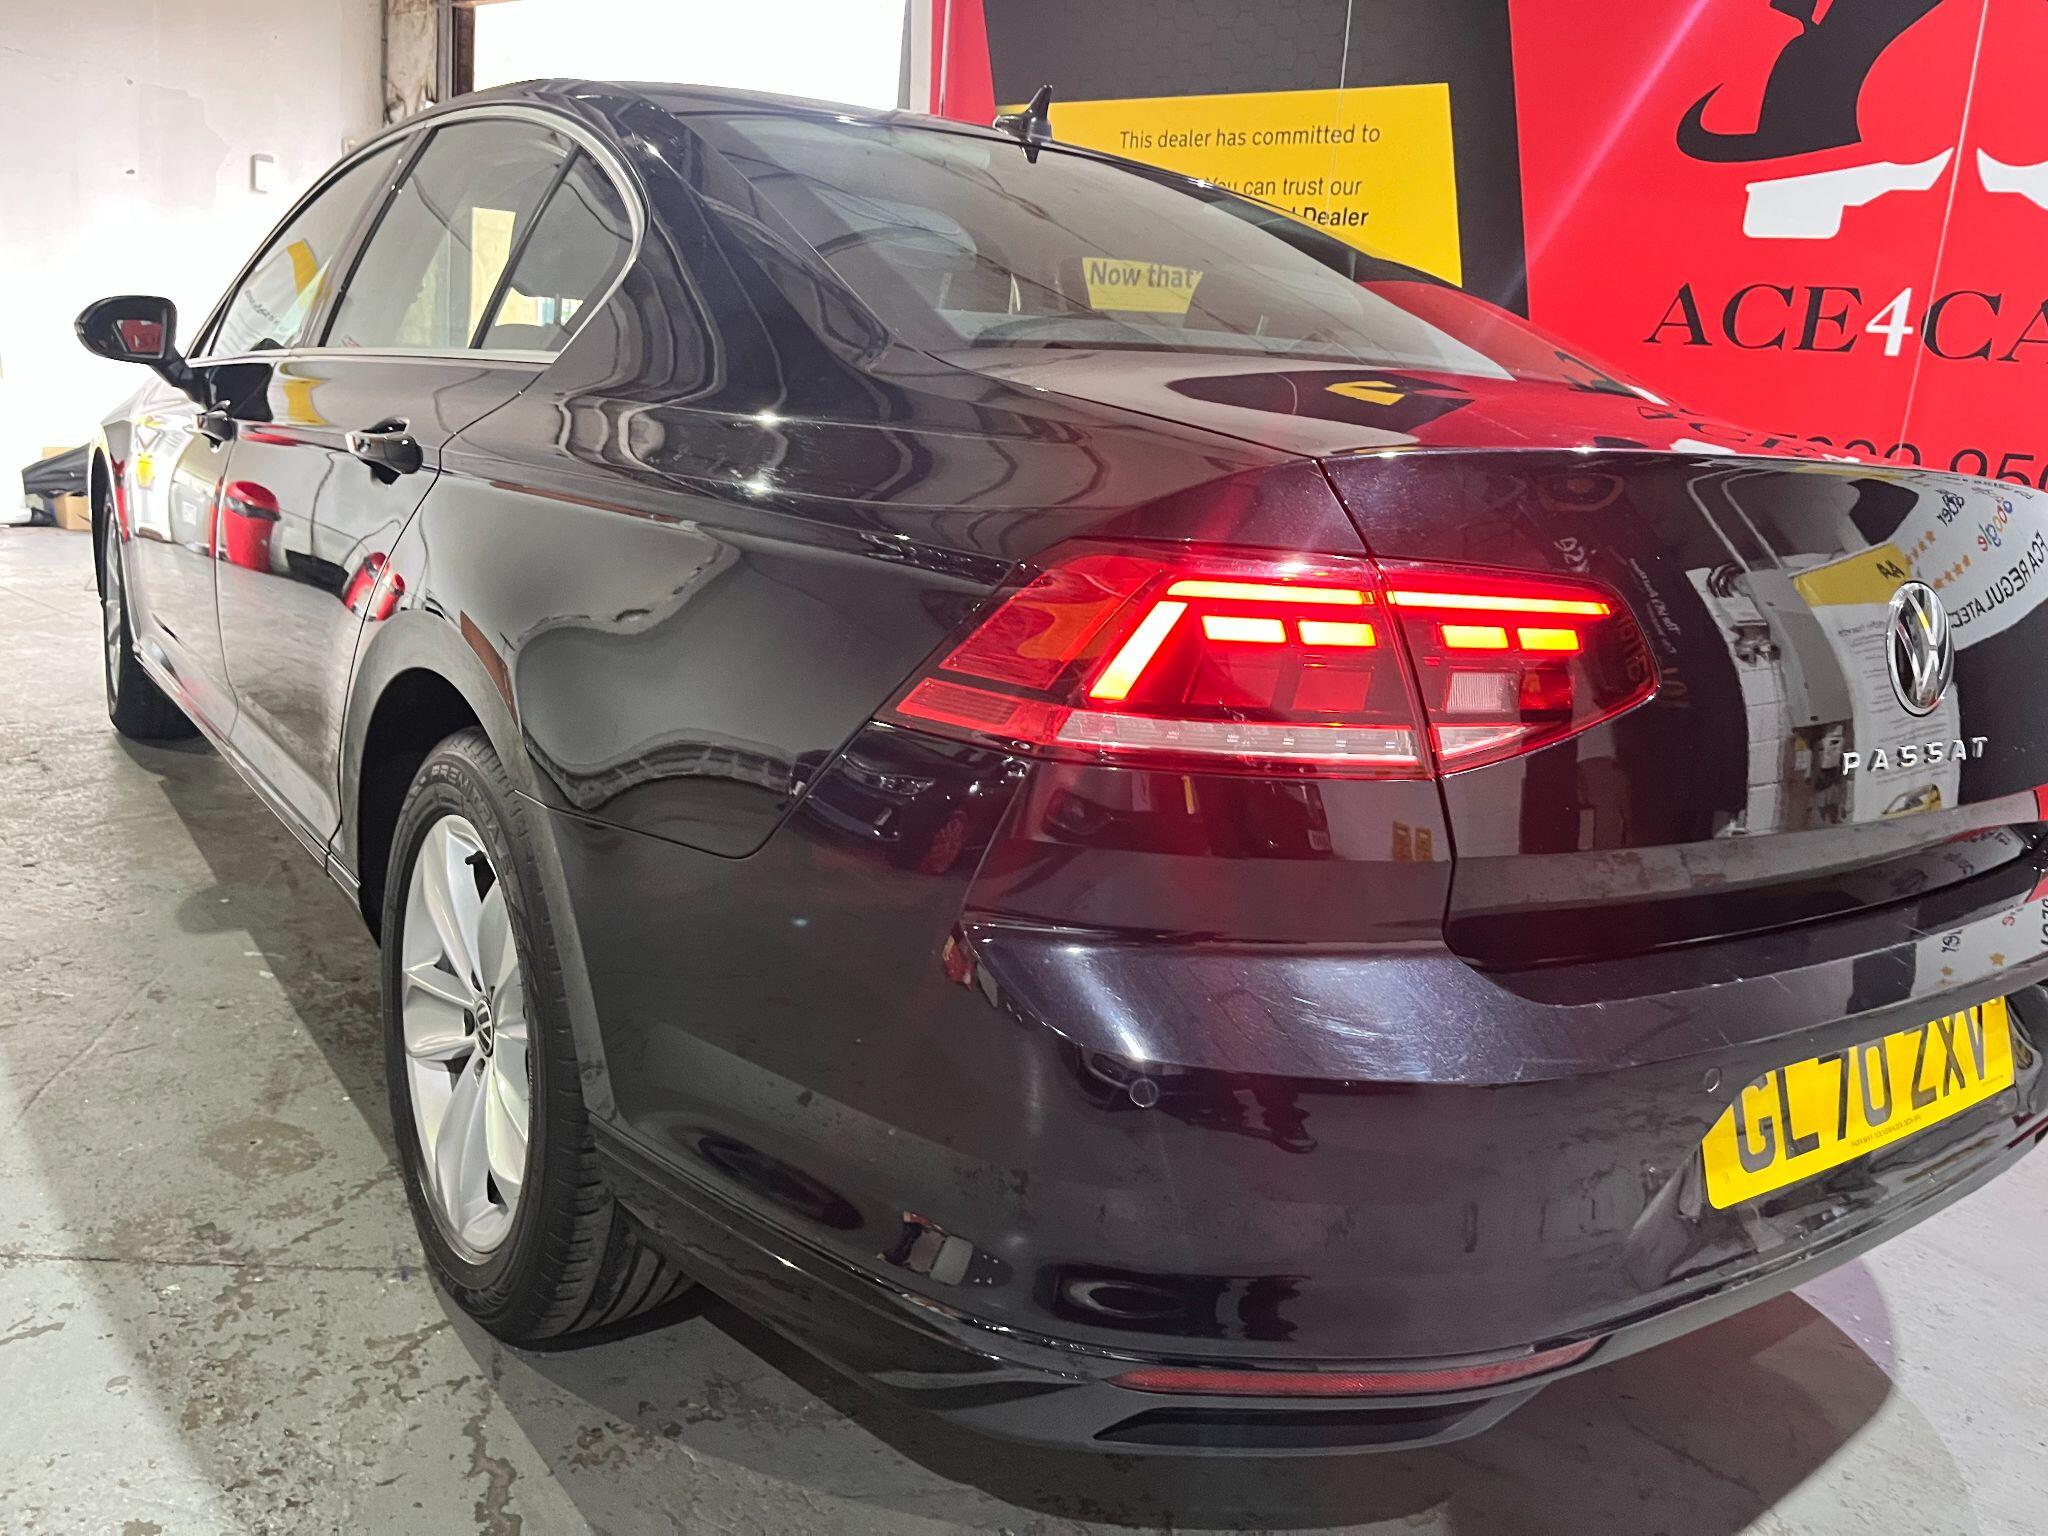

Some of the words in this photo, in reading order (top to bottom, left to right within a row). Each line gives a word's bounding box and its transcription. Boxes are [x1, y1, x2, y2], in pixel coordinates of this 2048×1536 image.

[1120, 131, 1152, 149] This
[1158, 130, 1212, 147] dealer
[1216, 128, 1246, 146] has
[1252, 124, 1355, 145] committed
[1362, 127, 1381, 143] to
[1243, 180, 1276, 196] can
[1283, 176, 1323, 195] trust
[1331, 179, 1362, 196] our
[1302, 206, 1370, 225] Dealer
[1090, 260, 1142, 287] Now
[1948, 447, 2048, 491] 95
[1842, 735, 1988, 776] PASSAT
[1728, 1038, 1893, 1174] GL70
[1904, 1004, 1986, 1111] ZXV
